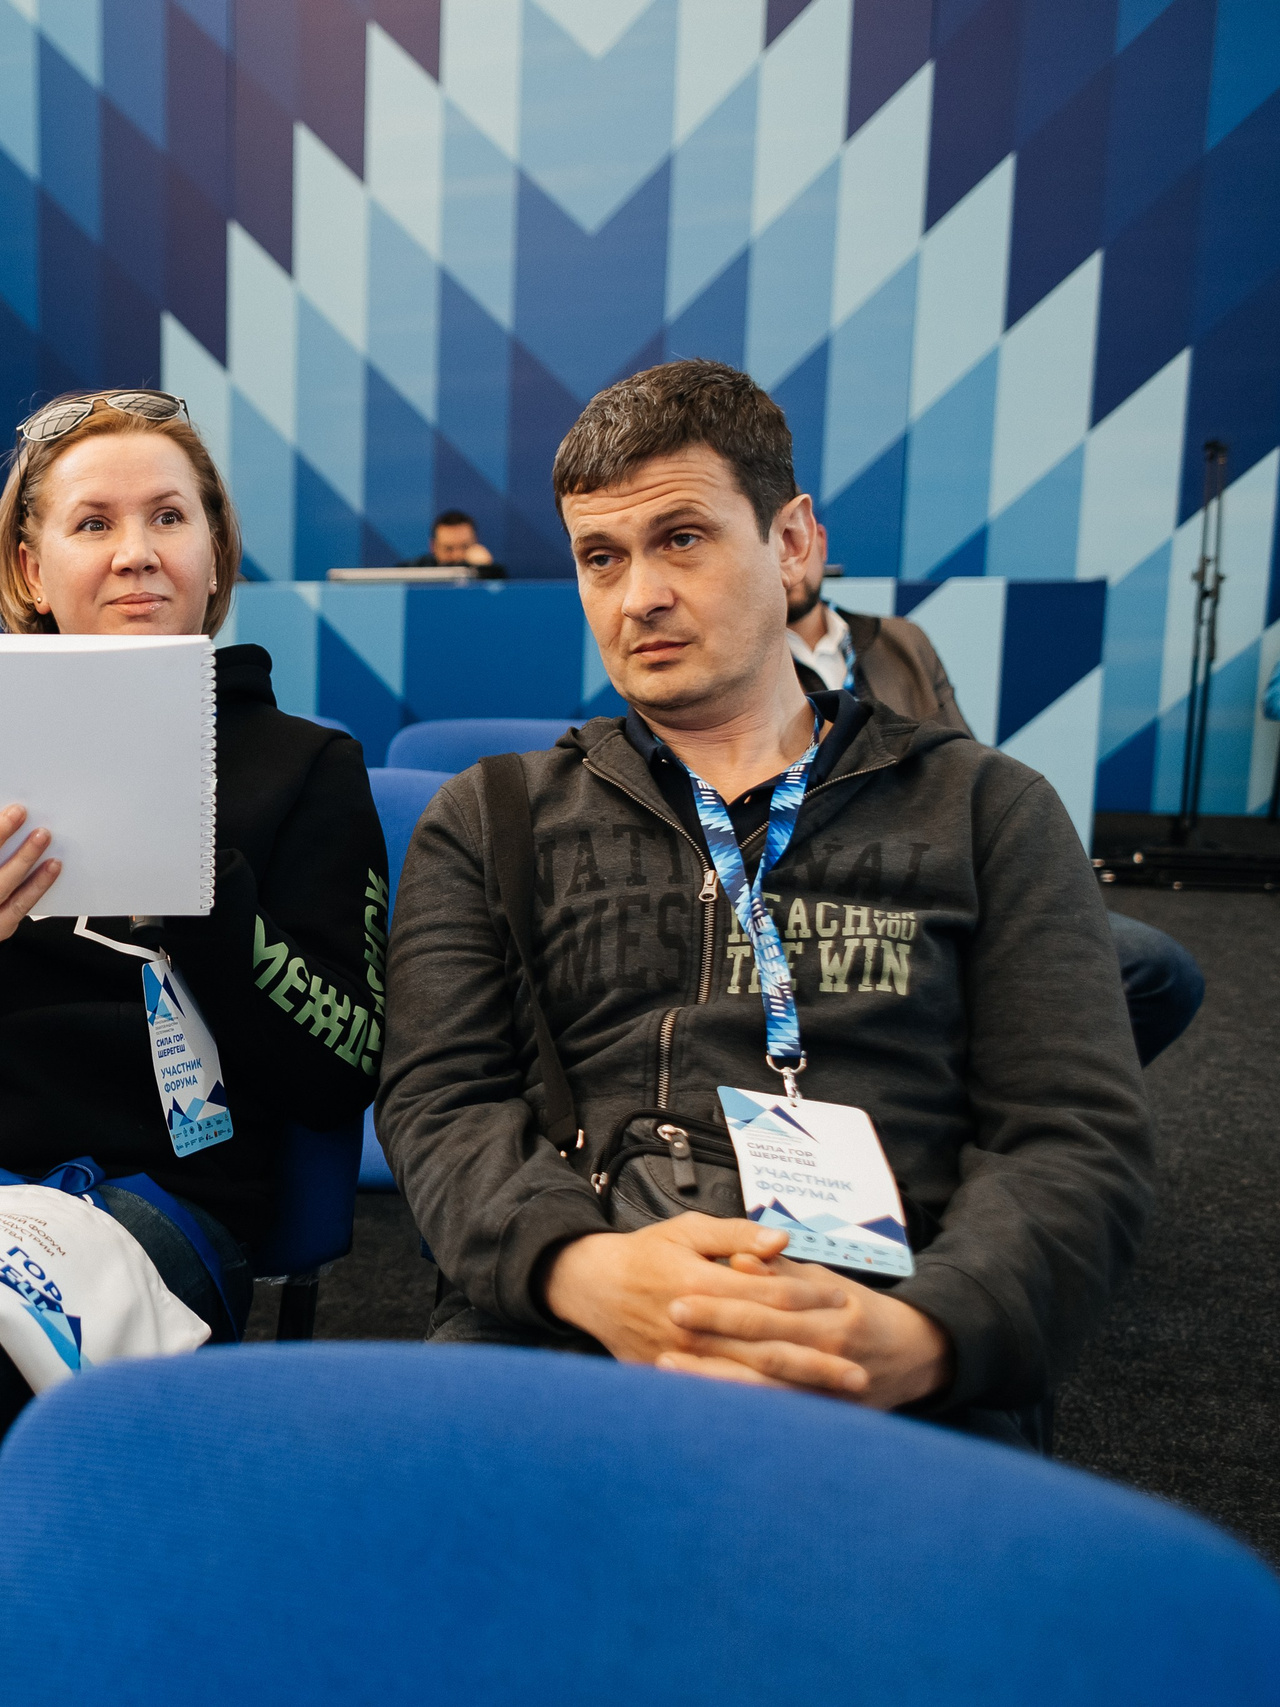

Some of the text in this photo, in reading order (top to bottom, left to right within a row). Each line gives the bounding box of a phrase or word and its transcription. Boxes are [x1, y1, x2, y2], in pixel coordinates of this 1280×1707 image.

[874, 917, 917, 942] YOU
[818, 938, 912, 997] WIN
[156, 1035, 173, 1049] СИЛА
[157, 1043, 186, 1060] ШЕРЕГЕШ
[160, 1057, 203, 1080] УЧАСТНИК
[163, 1074, 199, 1094] ФОРУМА
[747, 1140, 784, 1155] СИЛА
[749, 1149, 817, 1168] ШЕРЕГЕШ
[753, 1164, 854, 1192] УЧАСТНИК
[755, 1179, 840, 1204] ФОРУМА
